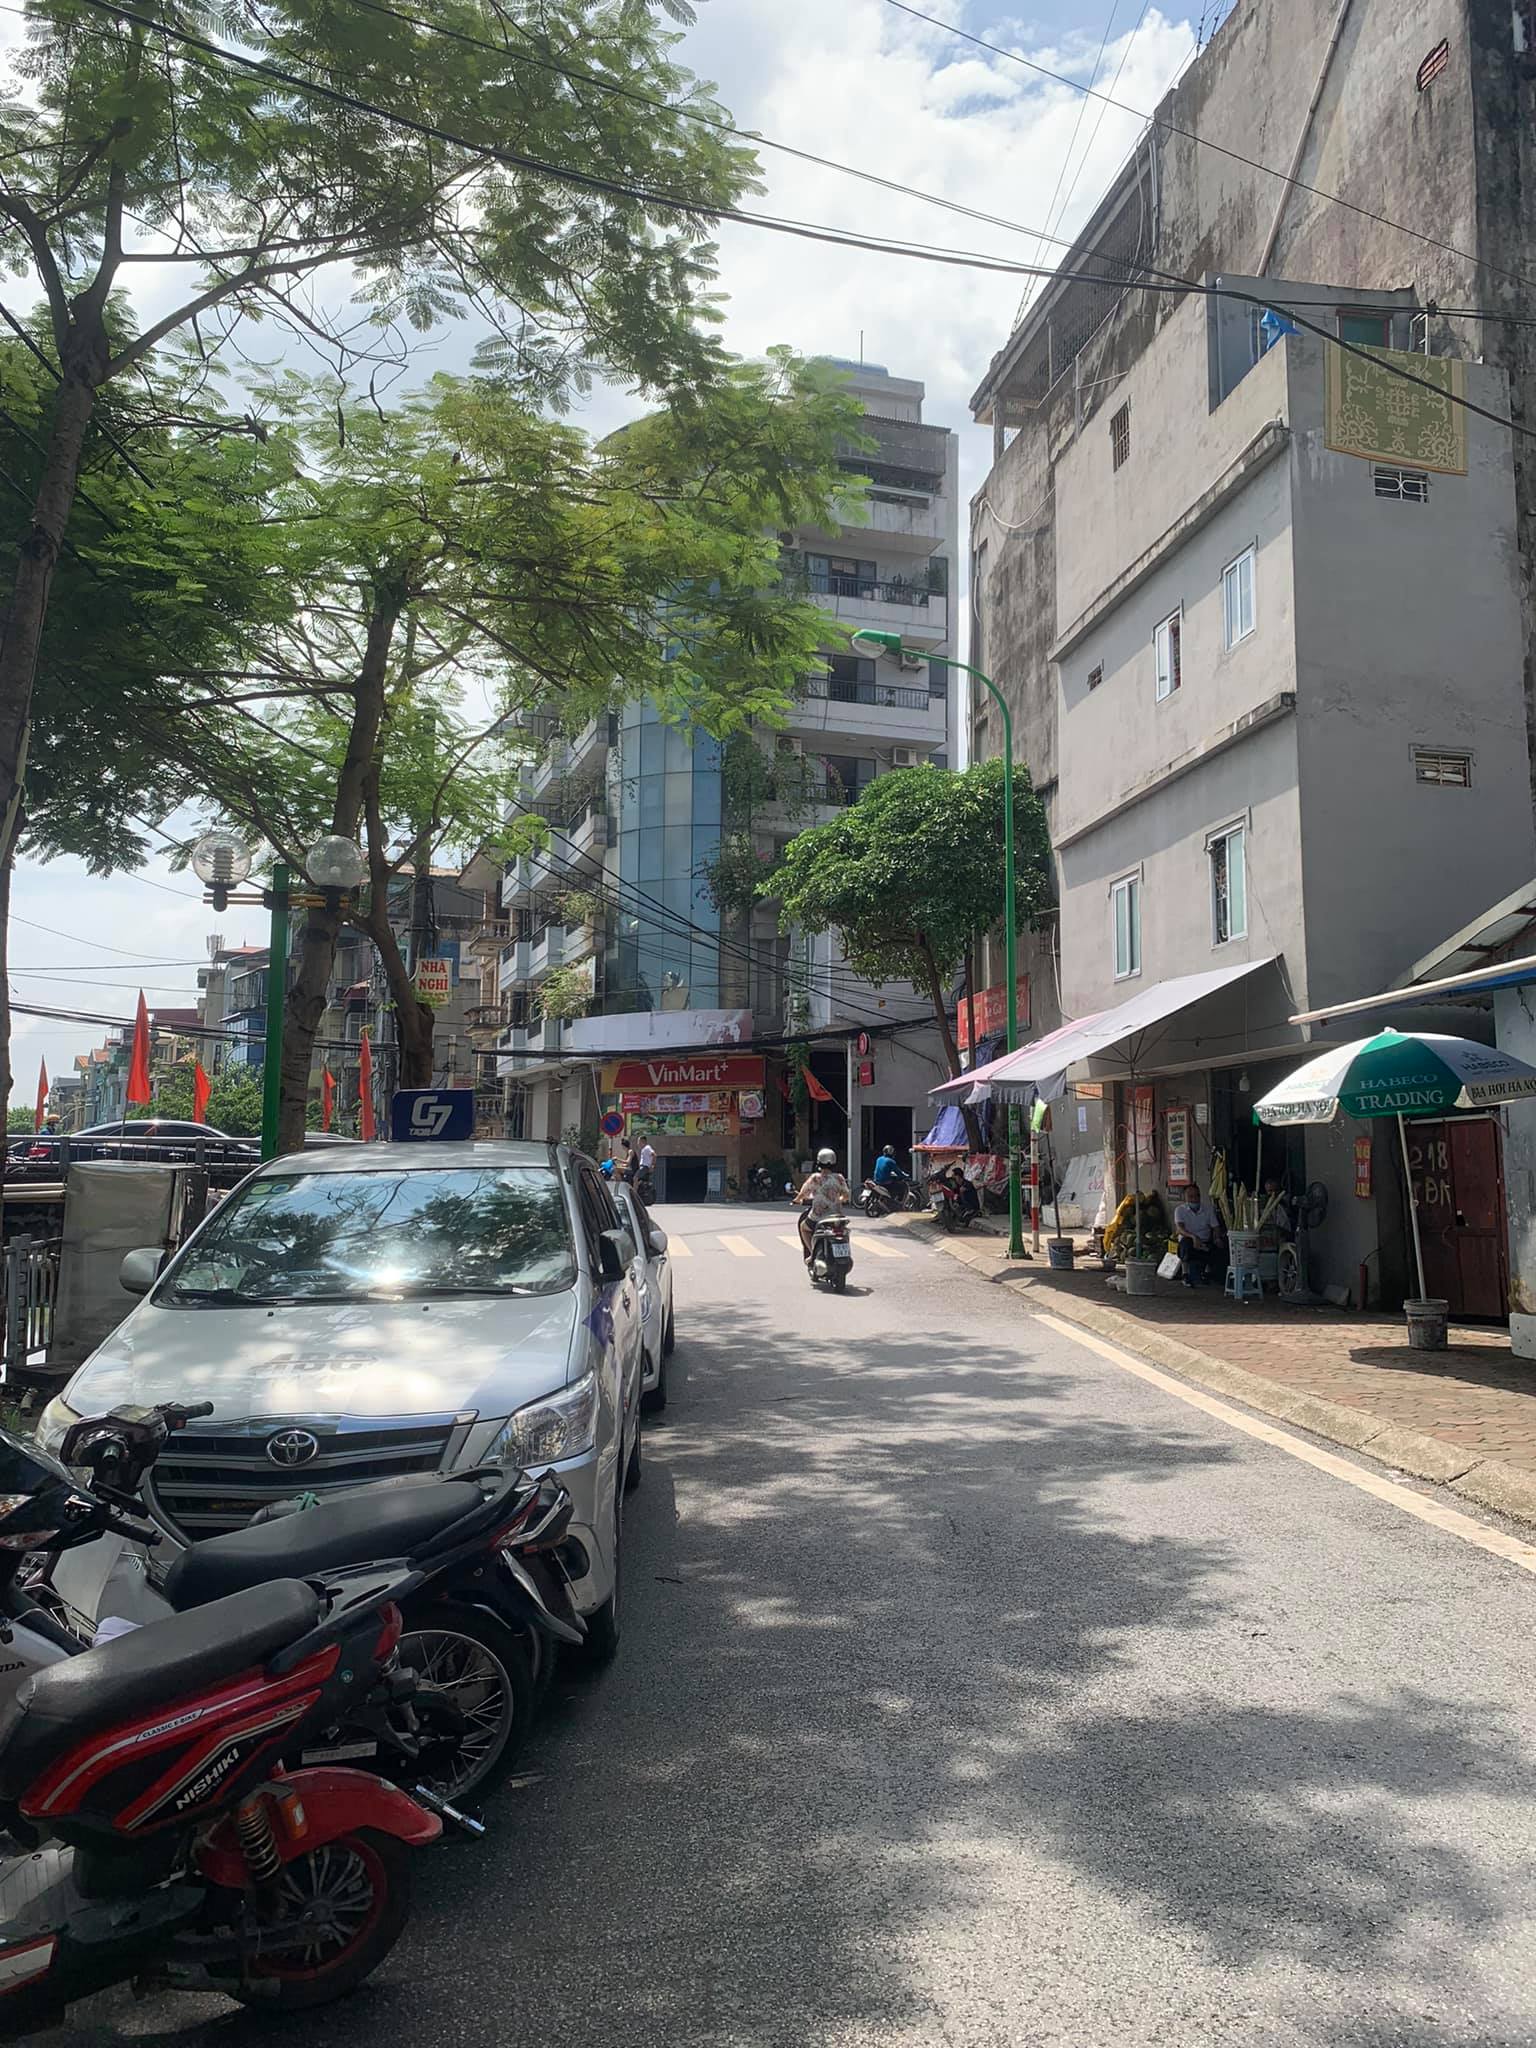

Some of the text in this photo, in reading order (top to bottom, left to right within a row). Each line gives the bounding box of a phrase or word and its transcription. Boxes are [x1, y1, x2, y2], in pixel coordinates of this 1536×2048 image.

[418, 974, 448, 990] NGHỈ
[1360, 1074, 1438, 1089] HABECO
[1355, 1090, 1444, 1110] TRADING
[412, 1096, 453, 1136] G7
[1410, 1141, 1448, 1172] 218
[142, 1722, 174, 1738] CLASSIC
[176, 1747, 240, 1810] NISHIKI
